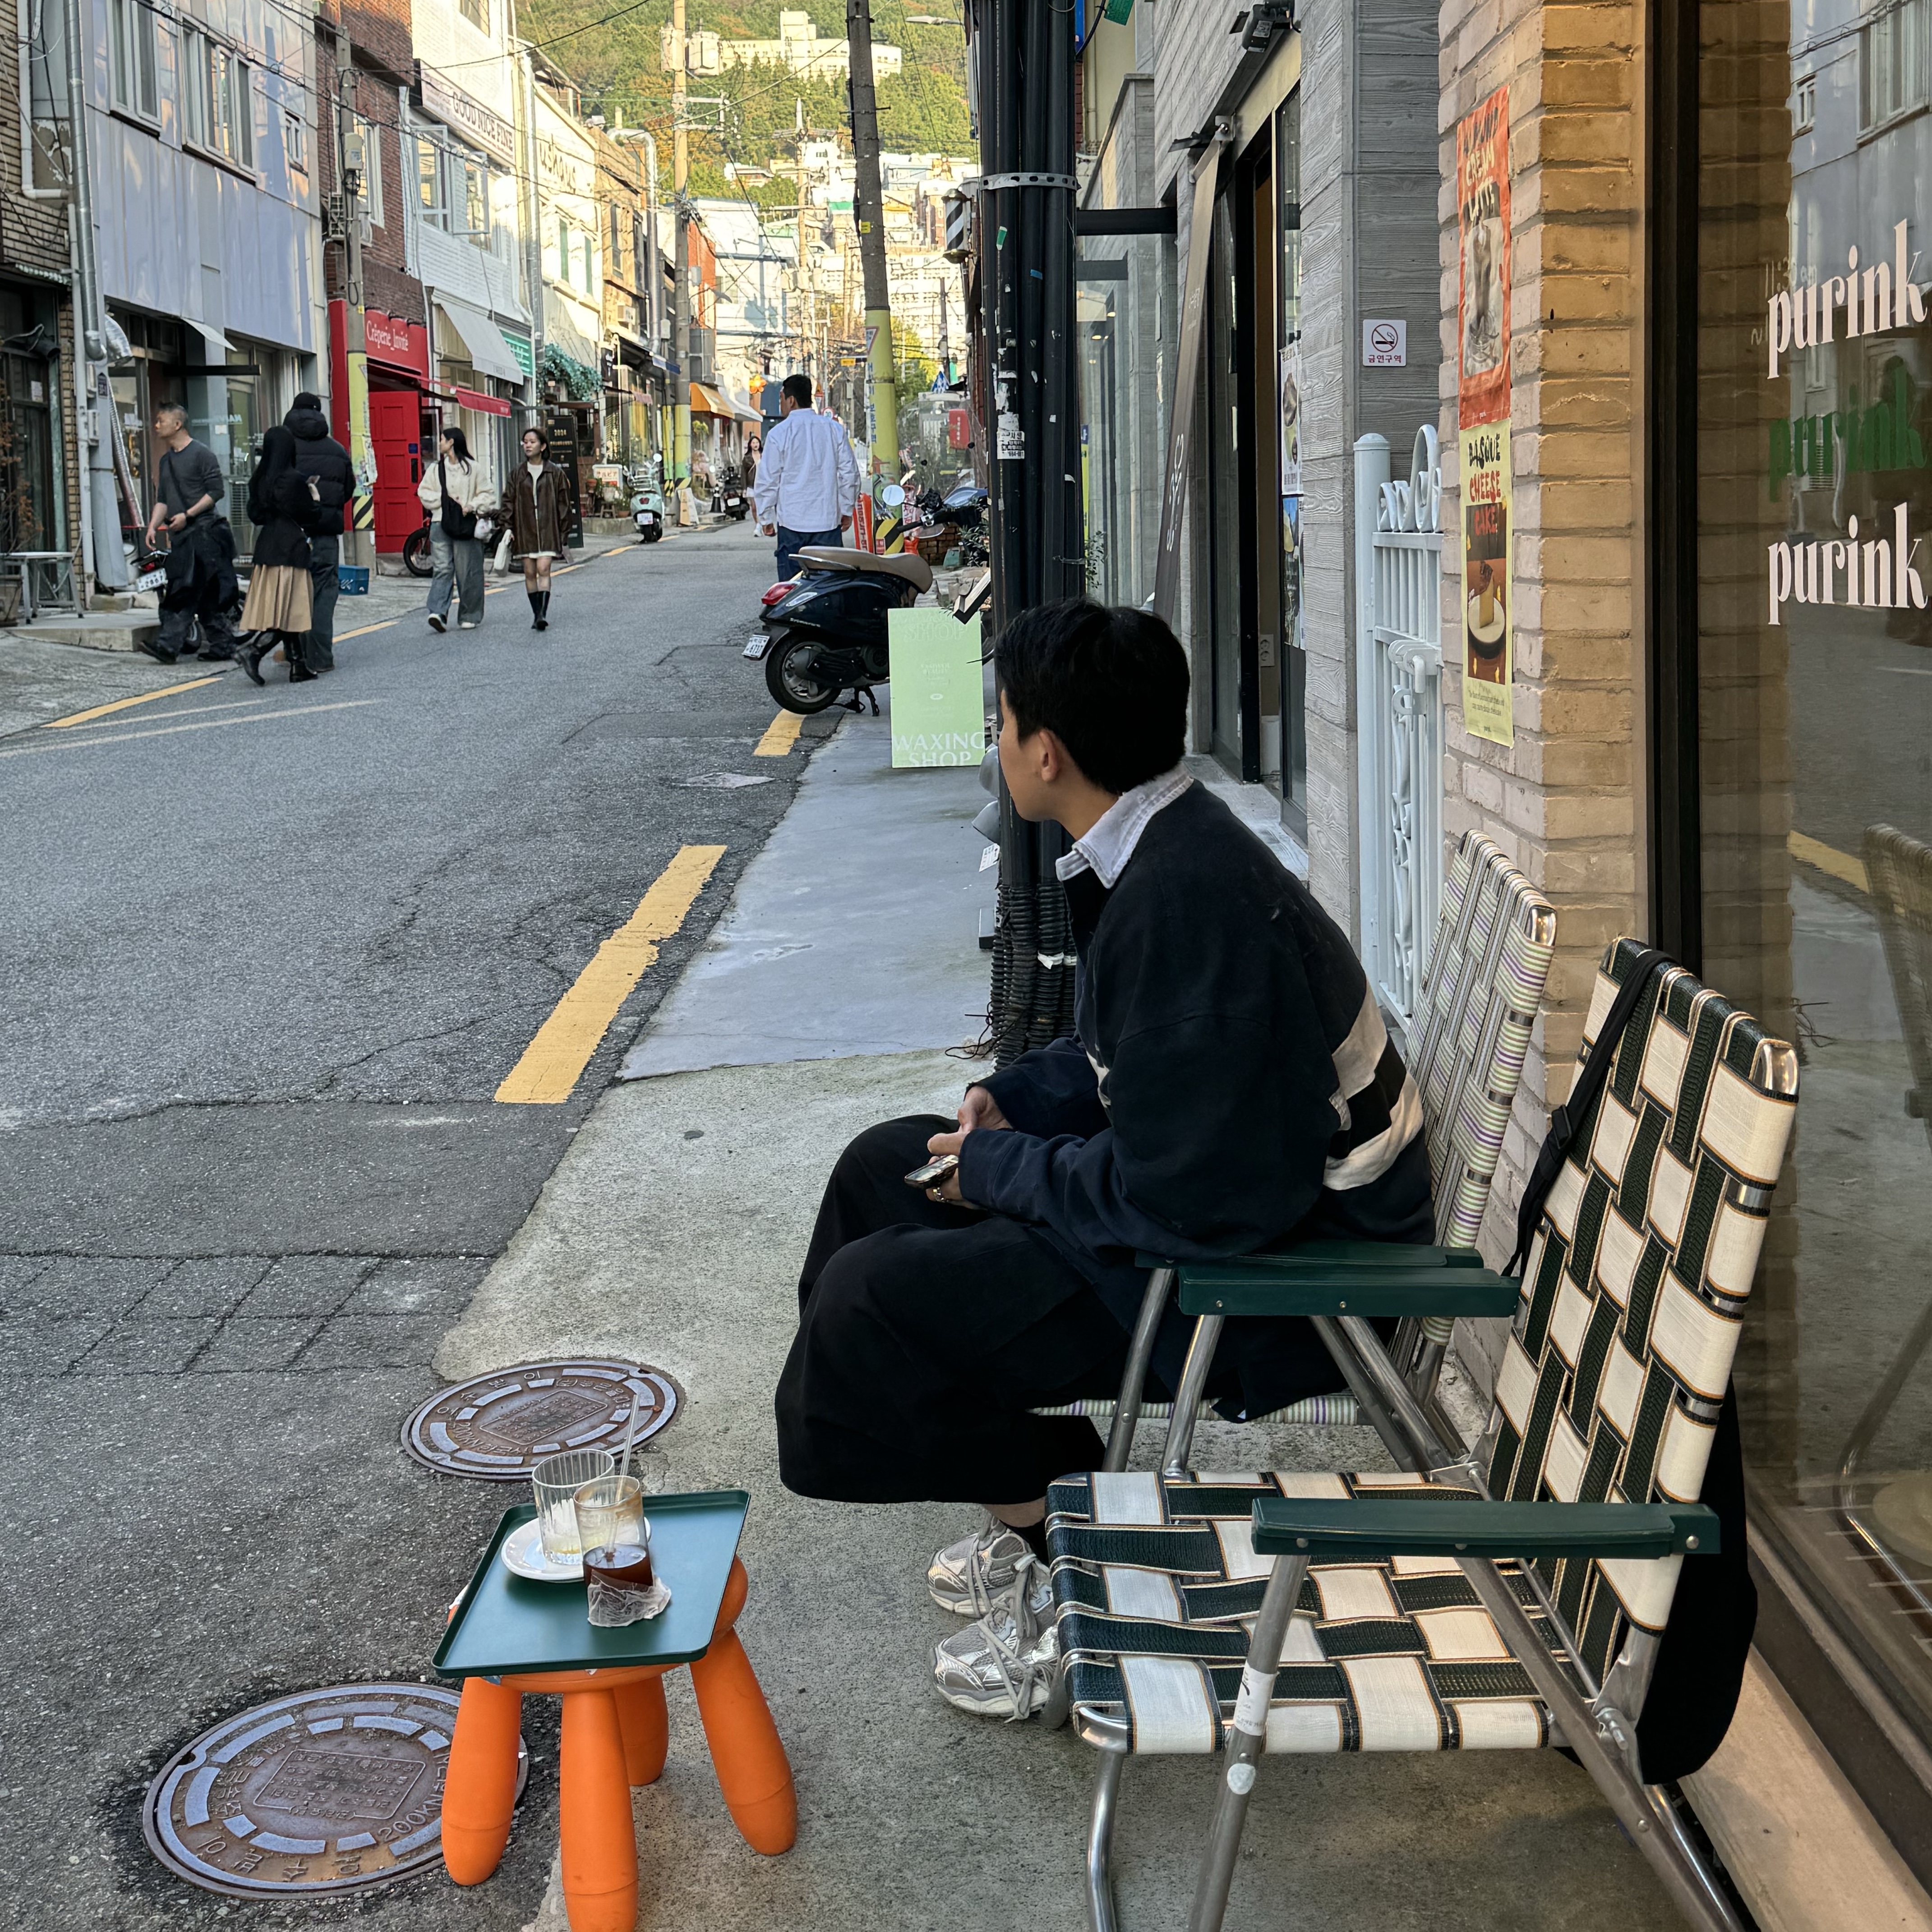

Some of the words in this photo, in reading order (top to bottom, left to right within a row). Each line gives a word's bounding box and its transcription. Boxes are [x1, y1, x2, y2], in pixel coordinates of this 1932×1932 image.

[453, 91, 476, 126] GOOD
[478, 109, 495, 140] NICE
[497, 122, 513, 152] FINE
[1466, 140, 1495, 187] CREAM
[1766, 218, 1928, 380] purink
[1368, 354, 1402, 363] 금연구역
[1469, 432, 1501, 469] BASQUE
[1768, 364, 1928, 503] purink
[1469, 470, 1501, 502] CHEESE
[1767, 502, 1928, 625] purink
[908, 751, 972, 767] SHOP
